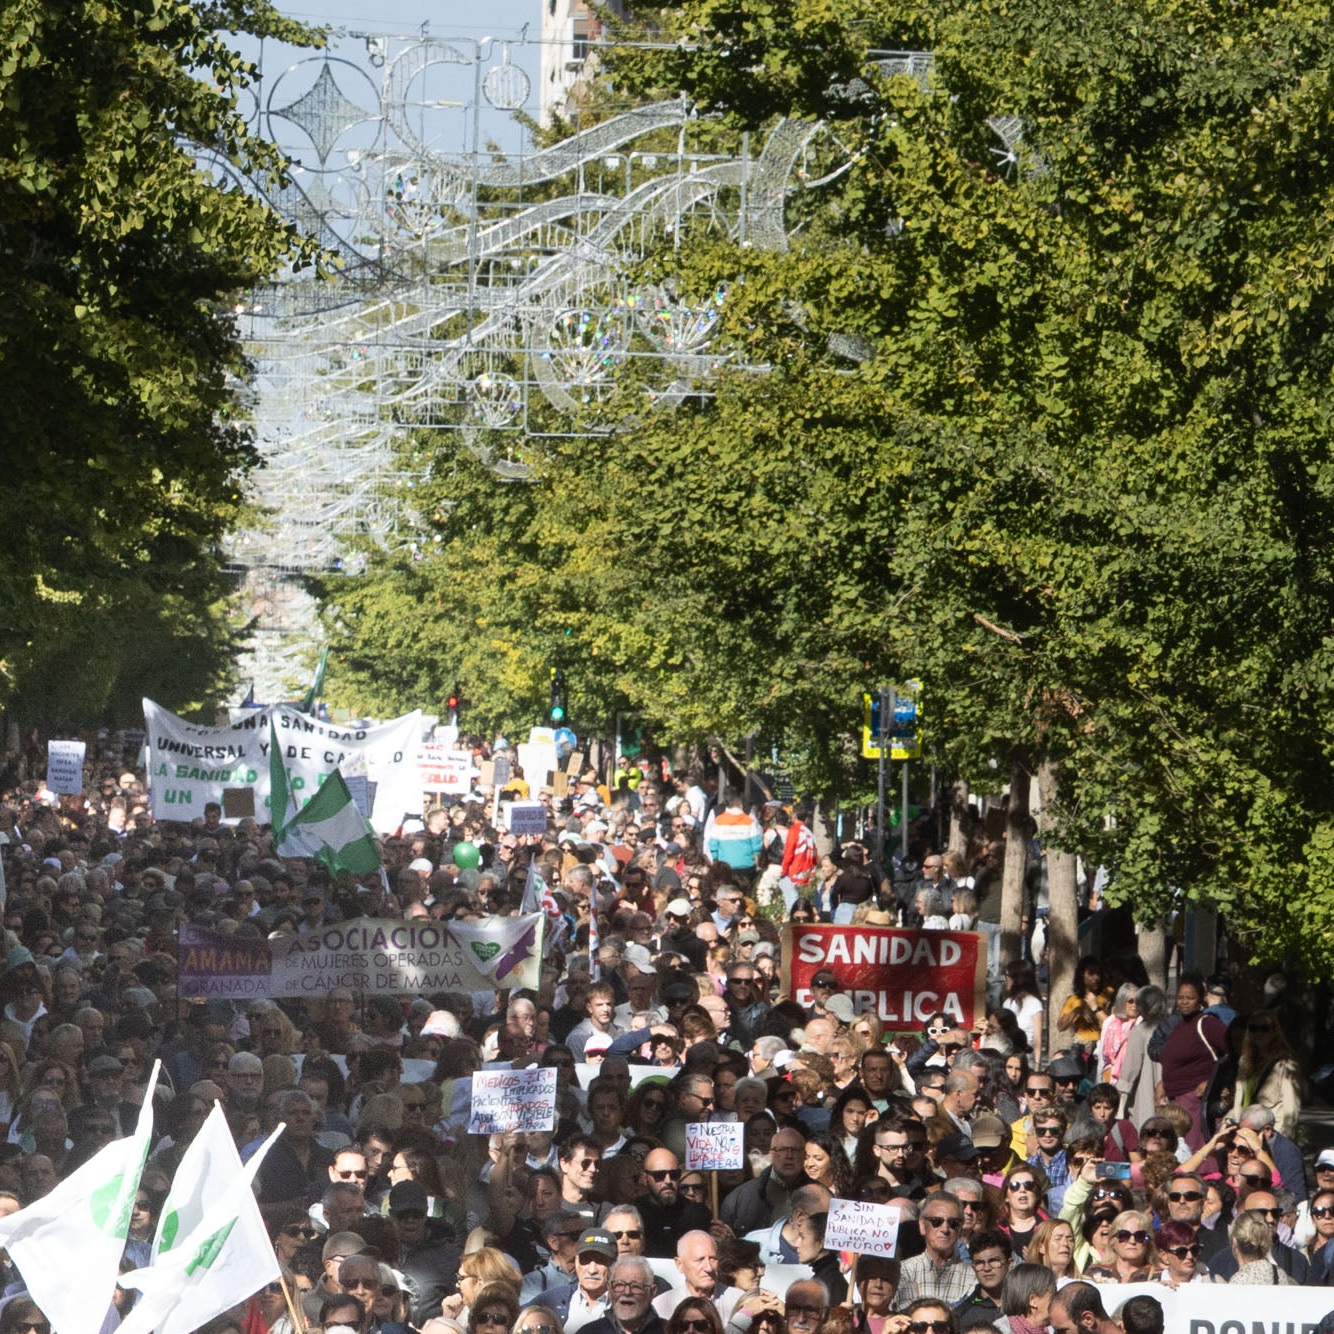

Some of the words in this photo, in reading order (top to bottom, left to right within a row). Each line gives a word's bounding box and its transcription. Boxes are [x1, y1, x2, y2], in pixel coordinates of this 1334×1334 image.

[281, 715, 367, 741] SANIDAD
[157, 737, 246, 759] UNIVERSAL
[259, 743, 269, 756] Y
[286, 745, 312, 759] DE
[175, 764, 258, 783] SANIDAD
[164, 789, 192, 804] UN
[798, 933, 962, 967] SANIDAD
[184, 947, 268, 972] AMAMA
[301, 953, 368, 969] MUJERES
[373, 950, 463, 968] OPERADAS
[183, 979, 267, 995] GRANADA
[376, 973, 398, 989] DE
[404, 972, 463, 989] MAMA
[796, 989, 965, 1023] PBLICA
[686, 1135, 712, 1149] VIDA
[854, 1201, 874, 1212] SIN
[833, 1210, 885, 1228] SANIDAD
[871, 1229, 890, 1239] NO
[831, 1237, 884, 1253] FUTURO
